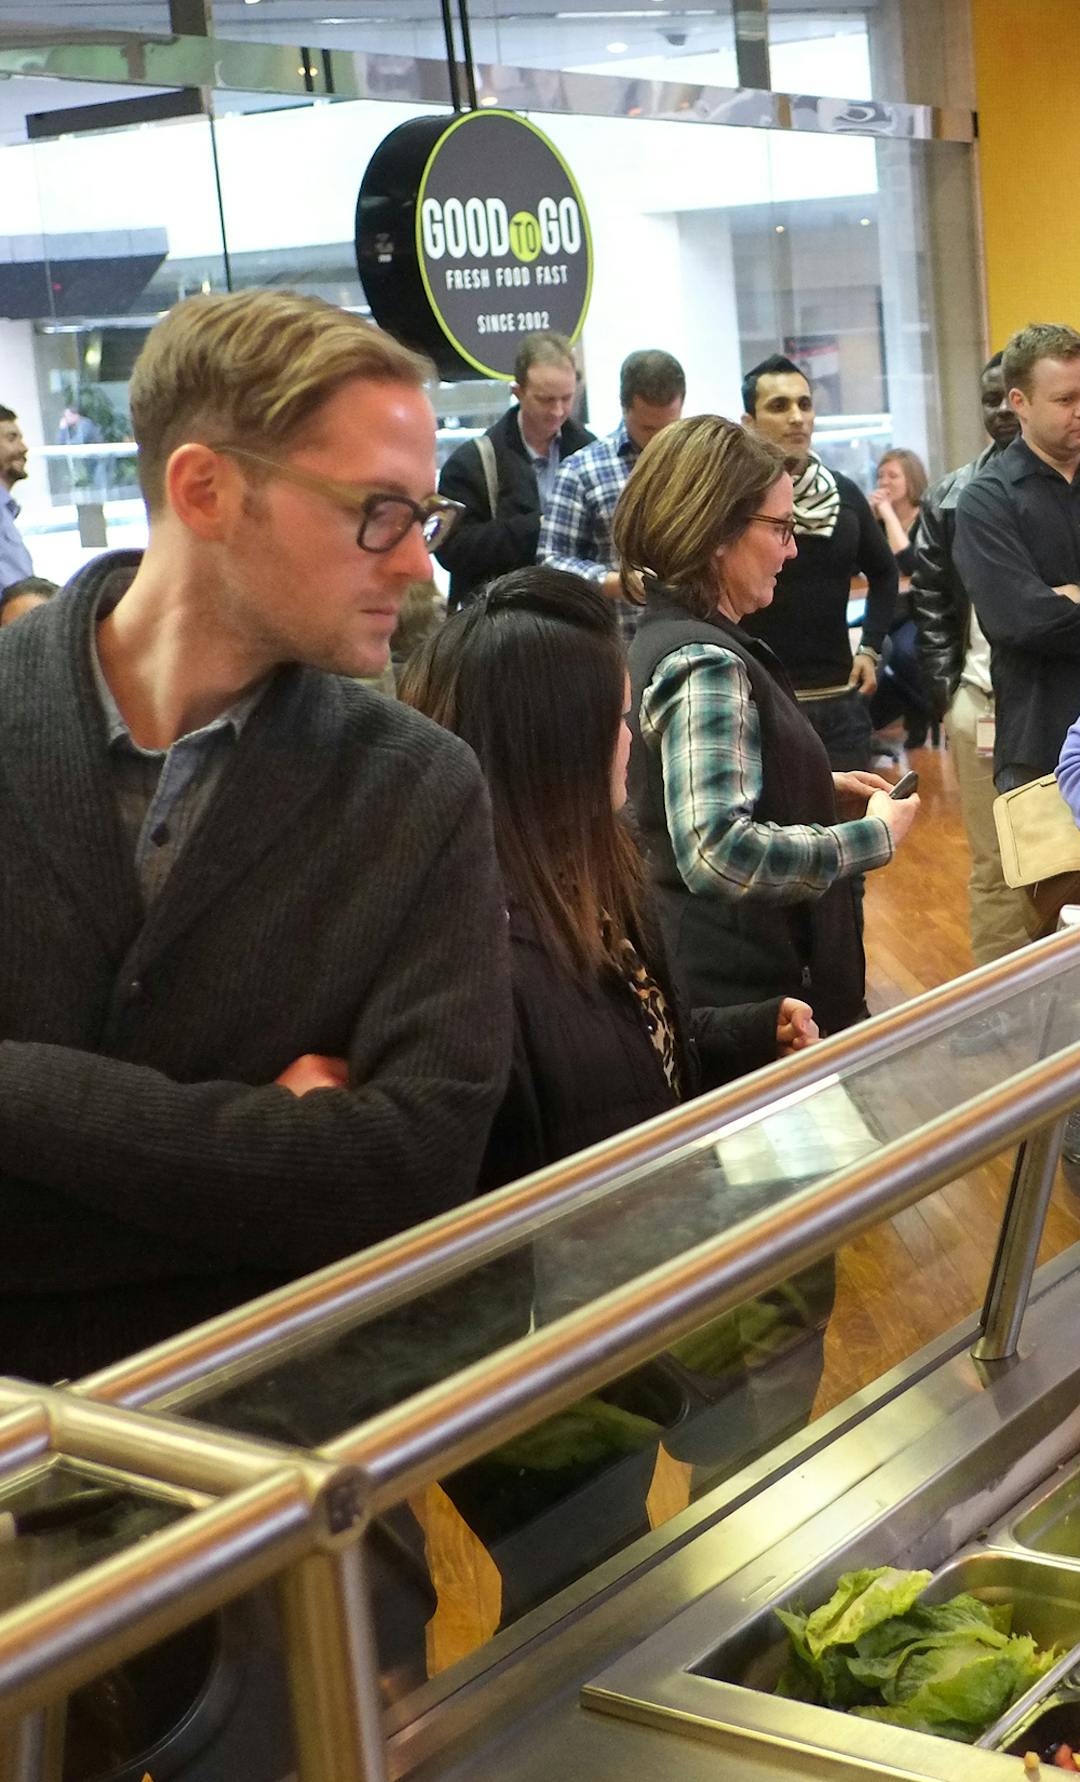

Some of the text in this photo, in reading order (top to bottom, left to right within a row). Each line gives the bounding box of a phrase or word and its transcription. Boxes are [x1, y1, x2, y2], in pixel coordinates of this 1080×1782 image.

[422, 197, 581, 259] GOOD TO GO
[445, 265, 568, 290] FRESH FOOD FAST
[477, 311, 549, 334] SINCE 2002
